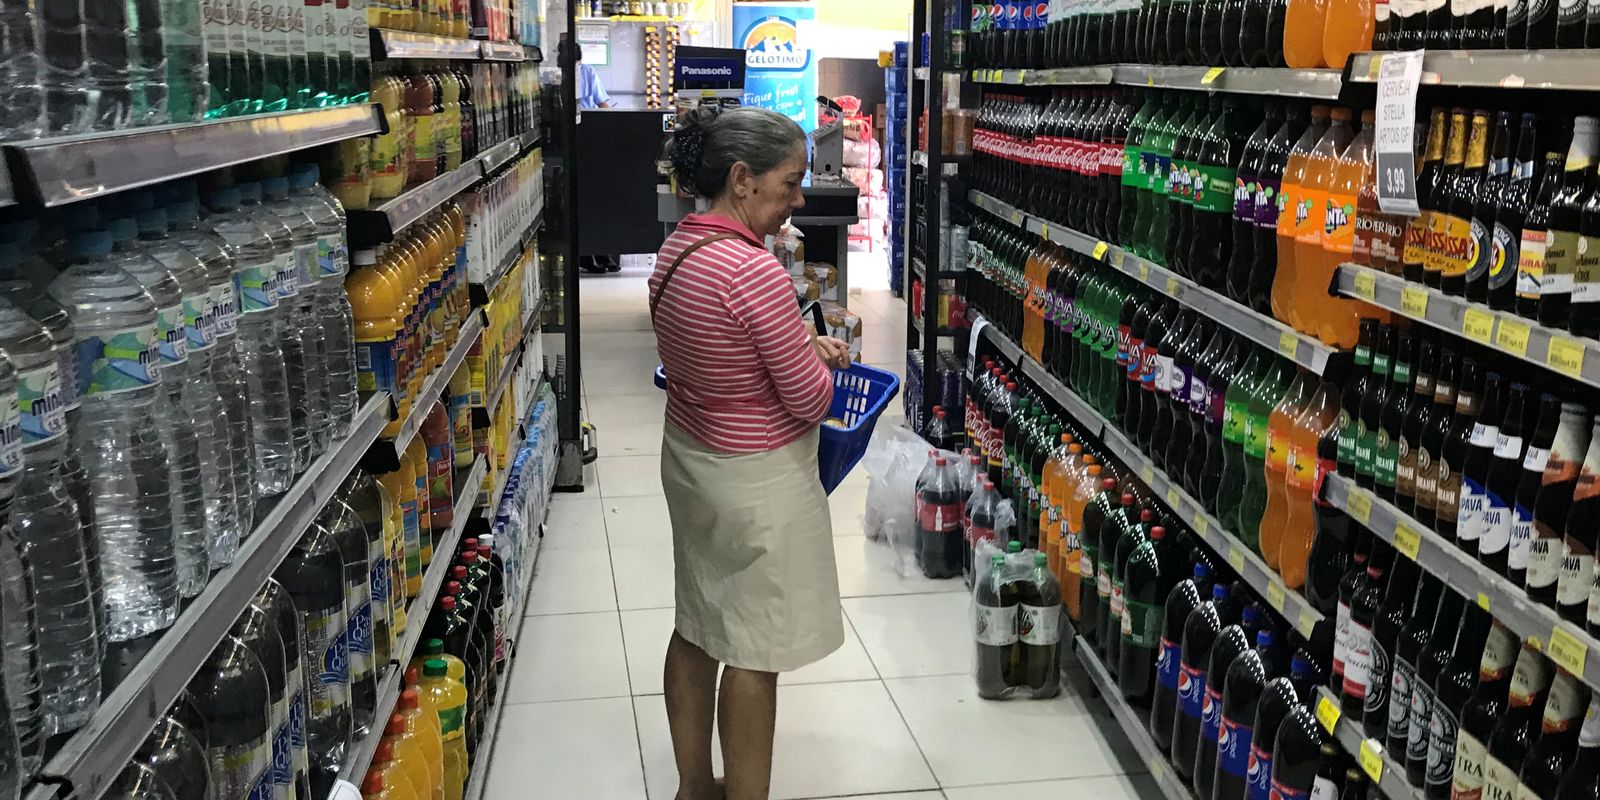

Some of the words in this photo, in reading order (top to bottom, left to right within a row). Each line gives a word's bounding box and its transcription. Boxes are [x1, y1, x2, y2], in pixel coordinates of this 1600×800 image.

[748, 55, 803, 65] GELOTIMO
[681, 65, 732, 76] Panasonic
[1382, 80, 1410, 98] CERVEJA
[743, 92, 772, 107] Fique
[1383, 104, 1405, 120] STELLA
[1379, 127, 1401, 145] ARTOIS
[1386, 167, 1405, 197] 3,99
